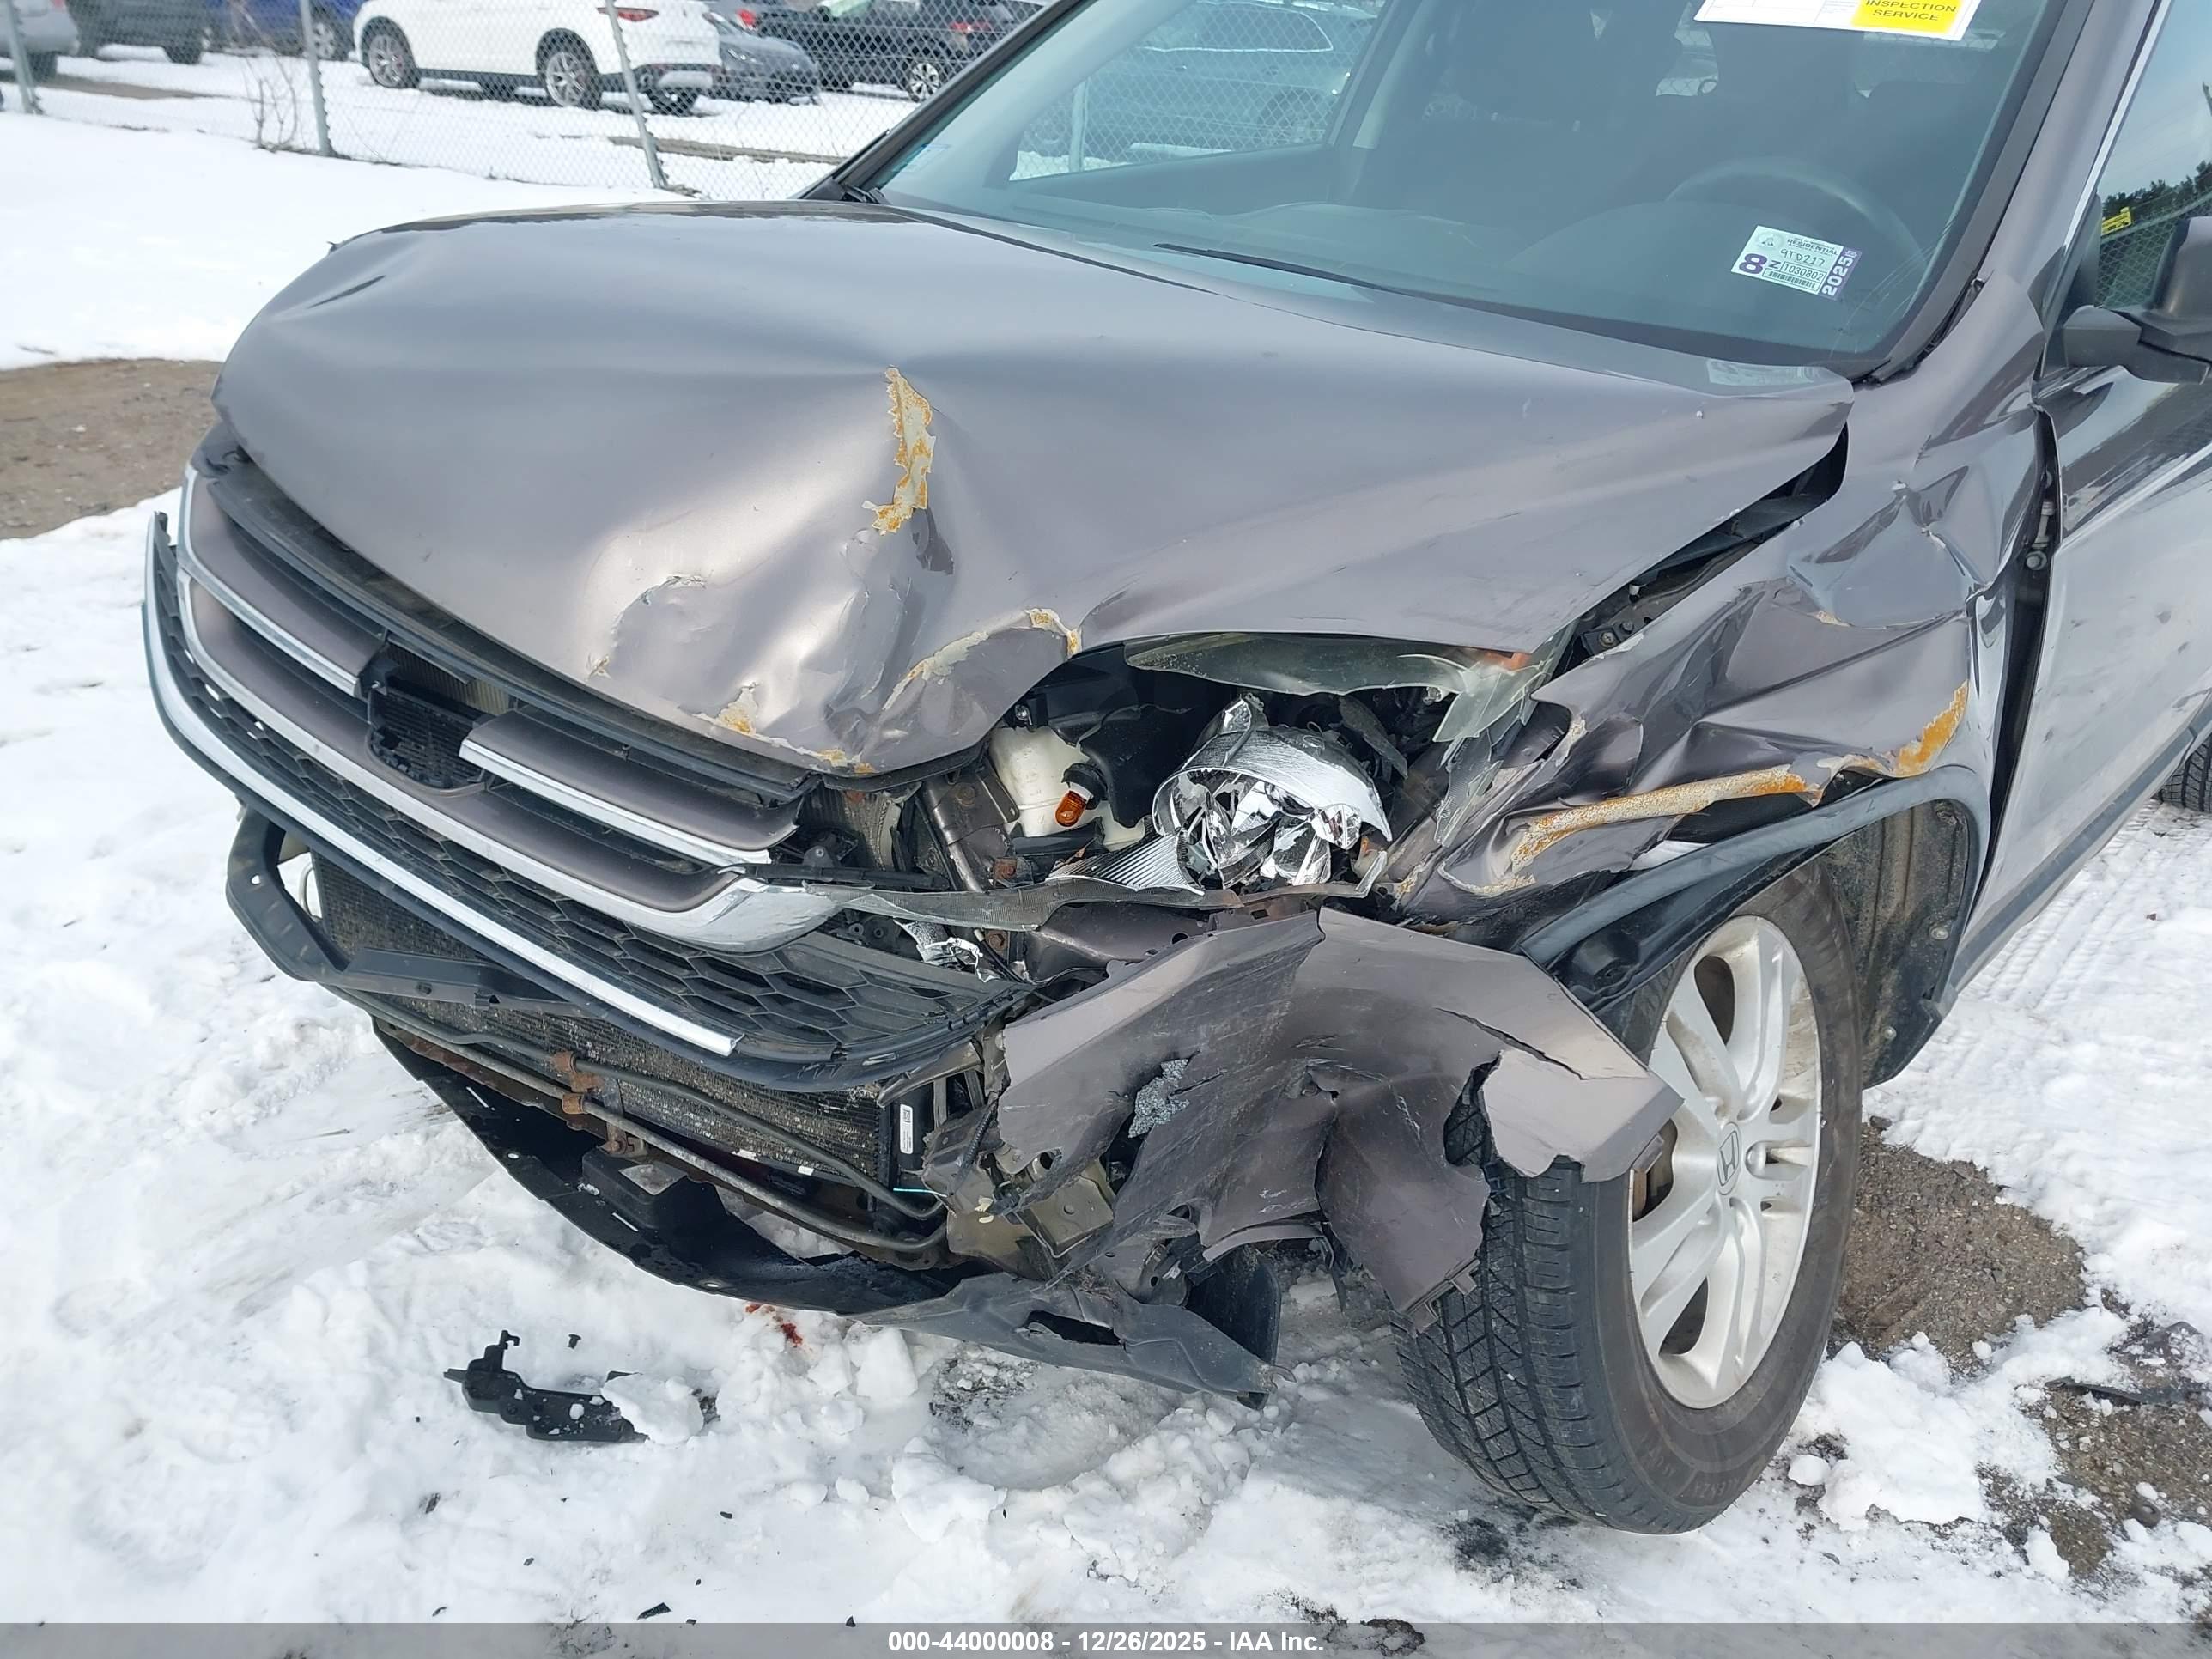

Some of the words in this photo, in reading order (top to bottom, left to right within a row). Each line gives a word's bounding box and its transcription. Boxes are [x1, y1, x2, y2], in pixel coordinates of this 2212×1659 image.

[1865, 0, 1957, 13] INSPECTION
[1872, 9, 1942, 21] SERVICE
[1787, 239, 1838, 256] RESIDENTIAL
[1739, 252, 1768, 275] 8
[1784, 264, 1824, 282] 1030802
[1822, 256, 1854, 296] 2025
